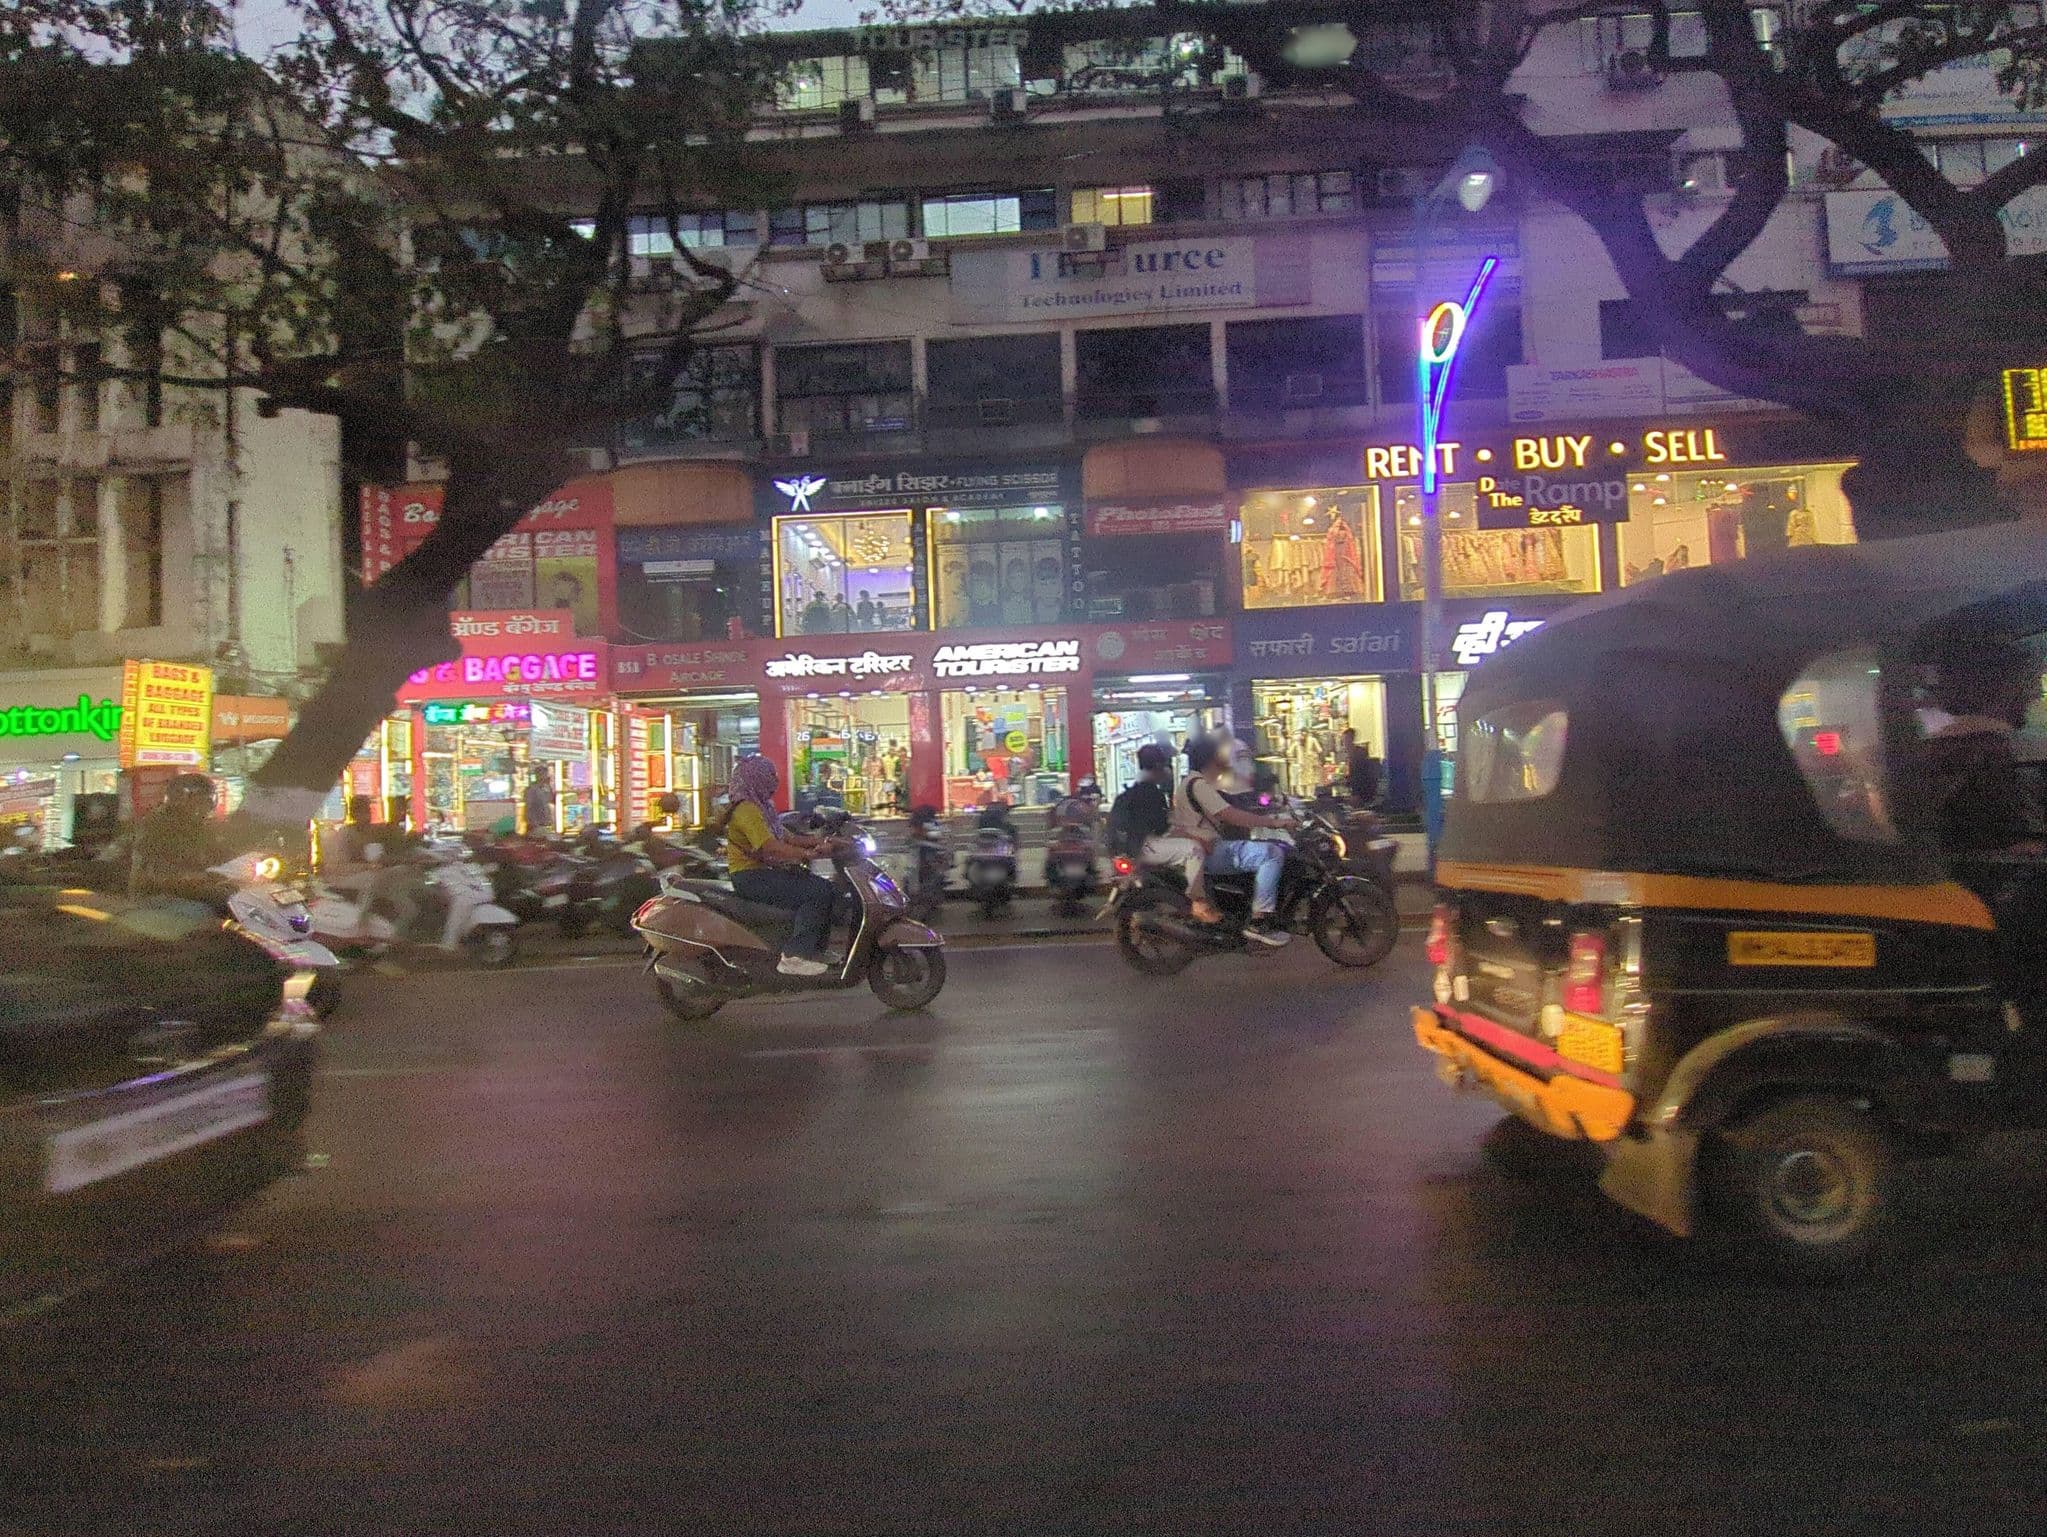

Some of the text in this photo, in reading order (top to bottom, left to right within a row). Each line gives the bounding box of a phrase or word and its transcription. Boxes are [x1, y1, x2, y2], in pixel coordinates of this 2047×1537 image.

[1023, 281, 1242, 308] Technologies Limited
[1515, 435, 1592, 470] BUY
[1645, 429, 1725, 463] SELL
[1489, 492, 1523, 508] The
[1524, 475, 1625, 510] Ramp
[933, 640, 1079, 663] AMERICAN
[1329, 629, 1401, 655] safari
[464, 653, 597, 683] BAGGAGE
[765, 652, 848, 678] अमेरिकन
[932, 655, 1081, 678] TOURISTER
